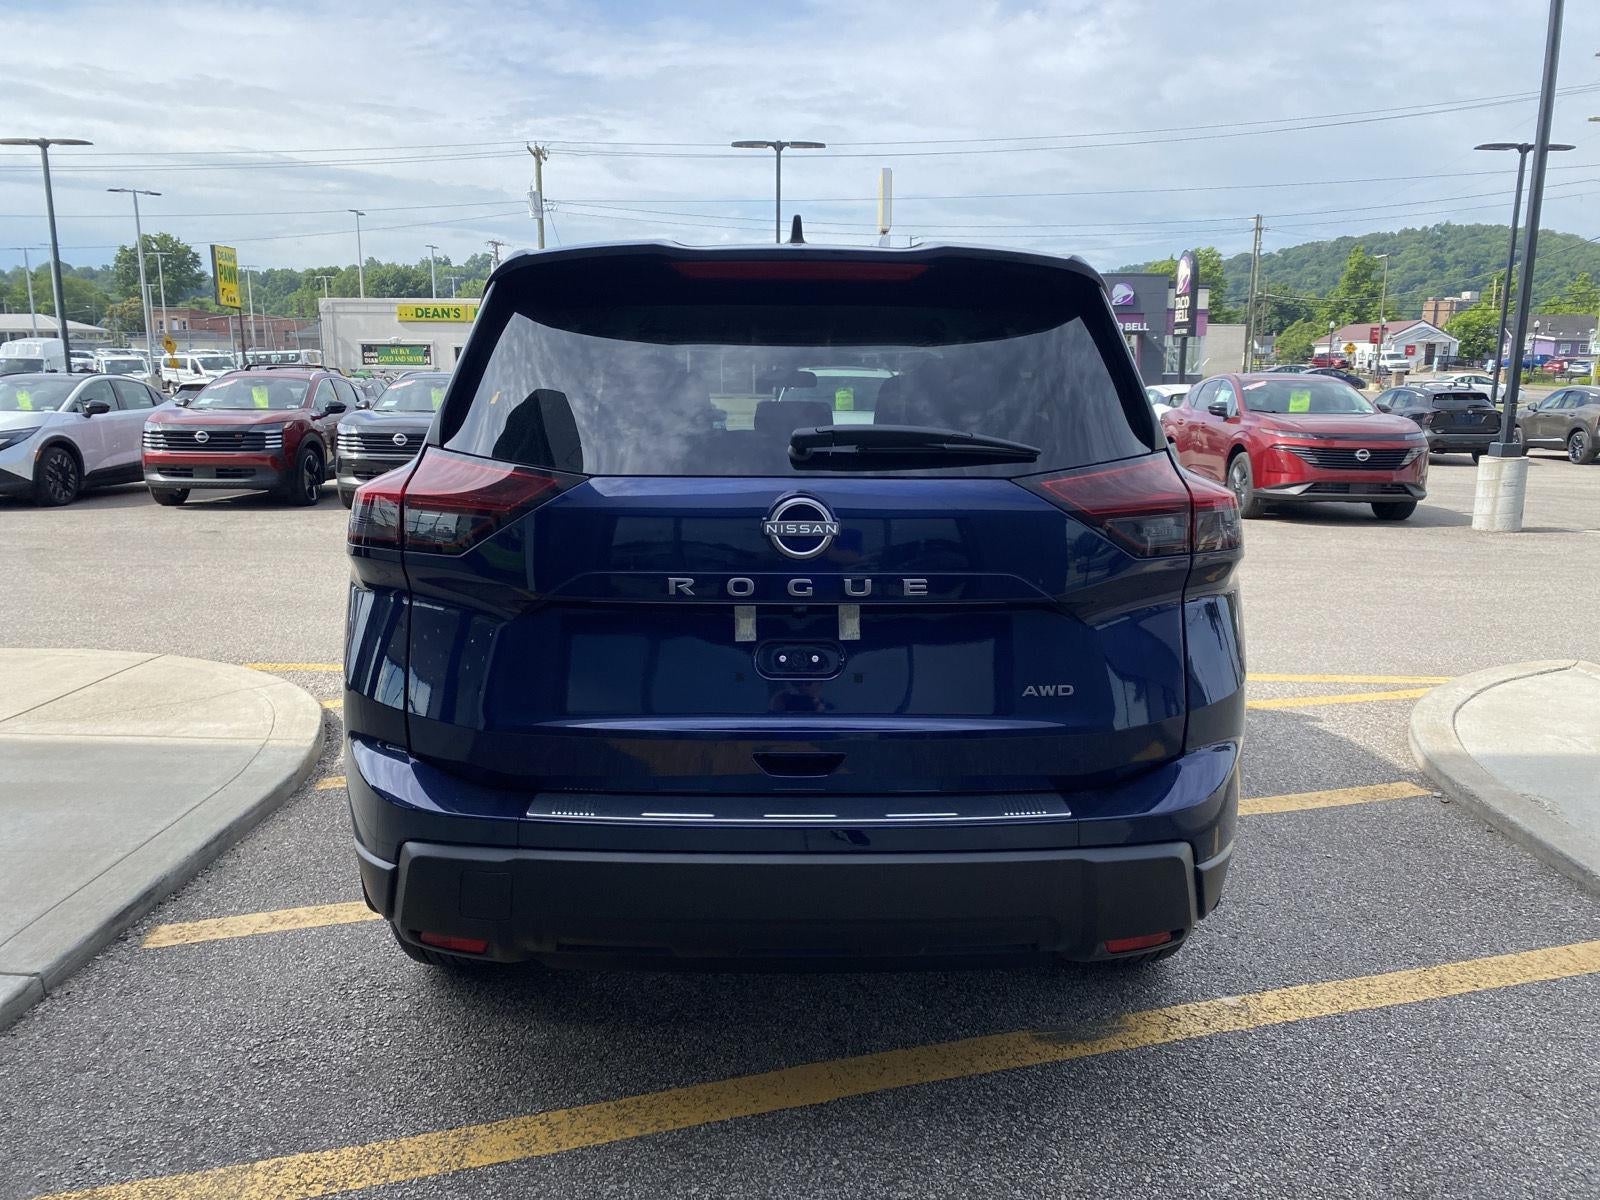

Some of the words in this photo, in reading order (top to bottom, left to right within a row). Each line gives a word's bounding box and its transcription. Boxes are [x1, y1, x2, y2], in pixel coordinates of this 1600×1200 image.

[218, 263, 238, 285] PAWN
[415, 307, 461, 319] DEAN'S
[1174, 309, 1189, 323] BELL
[1124, 322, 1150, 331] BELL
[379, 355, 394, 363] GOLD
[395, 355, 406, 363] AND
[406, 355, 422, 363] SILVER
[766, 524, 838, 534] NISSAN
[668, 577, 928, 597] ROGUE
[1022, 684, 1075, 697] AWD
